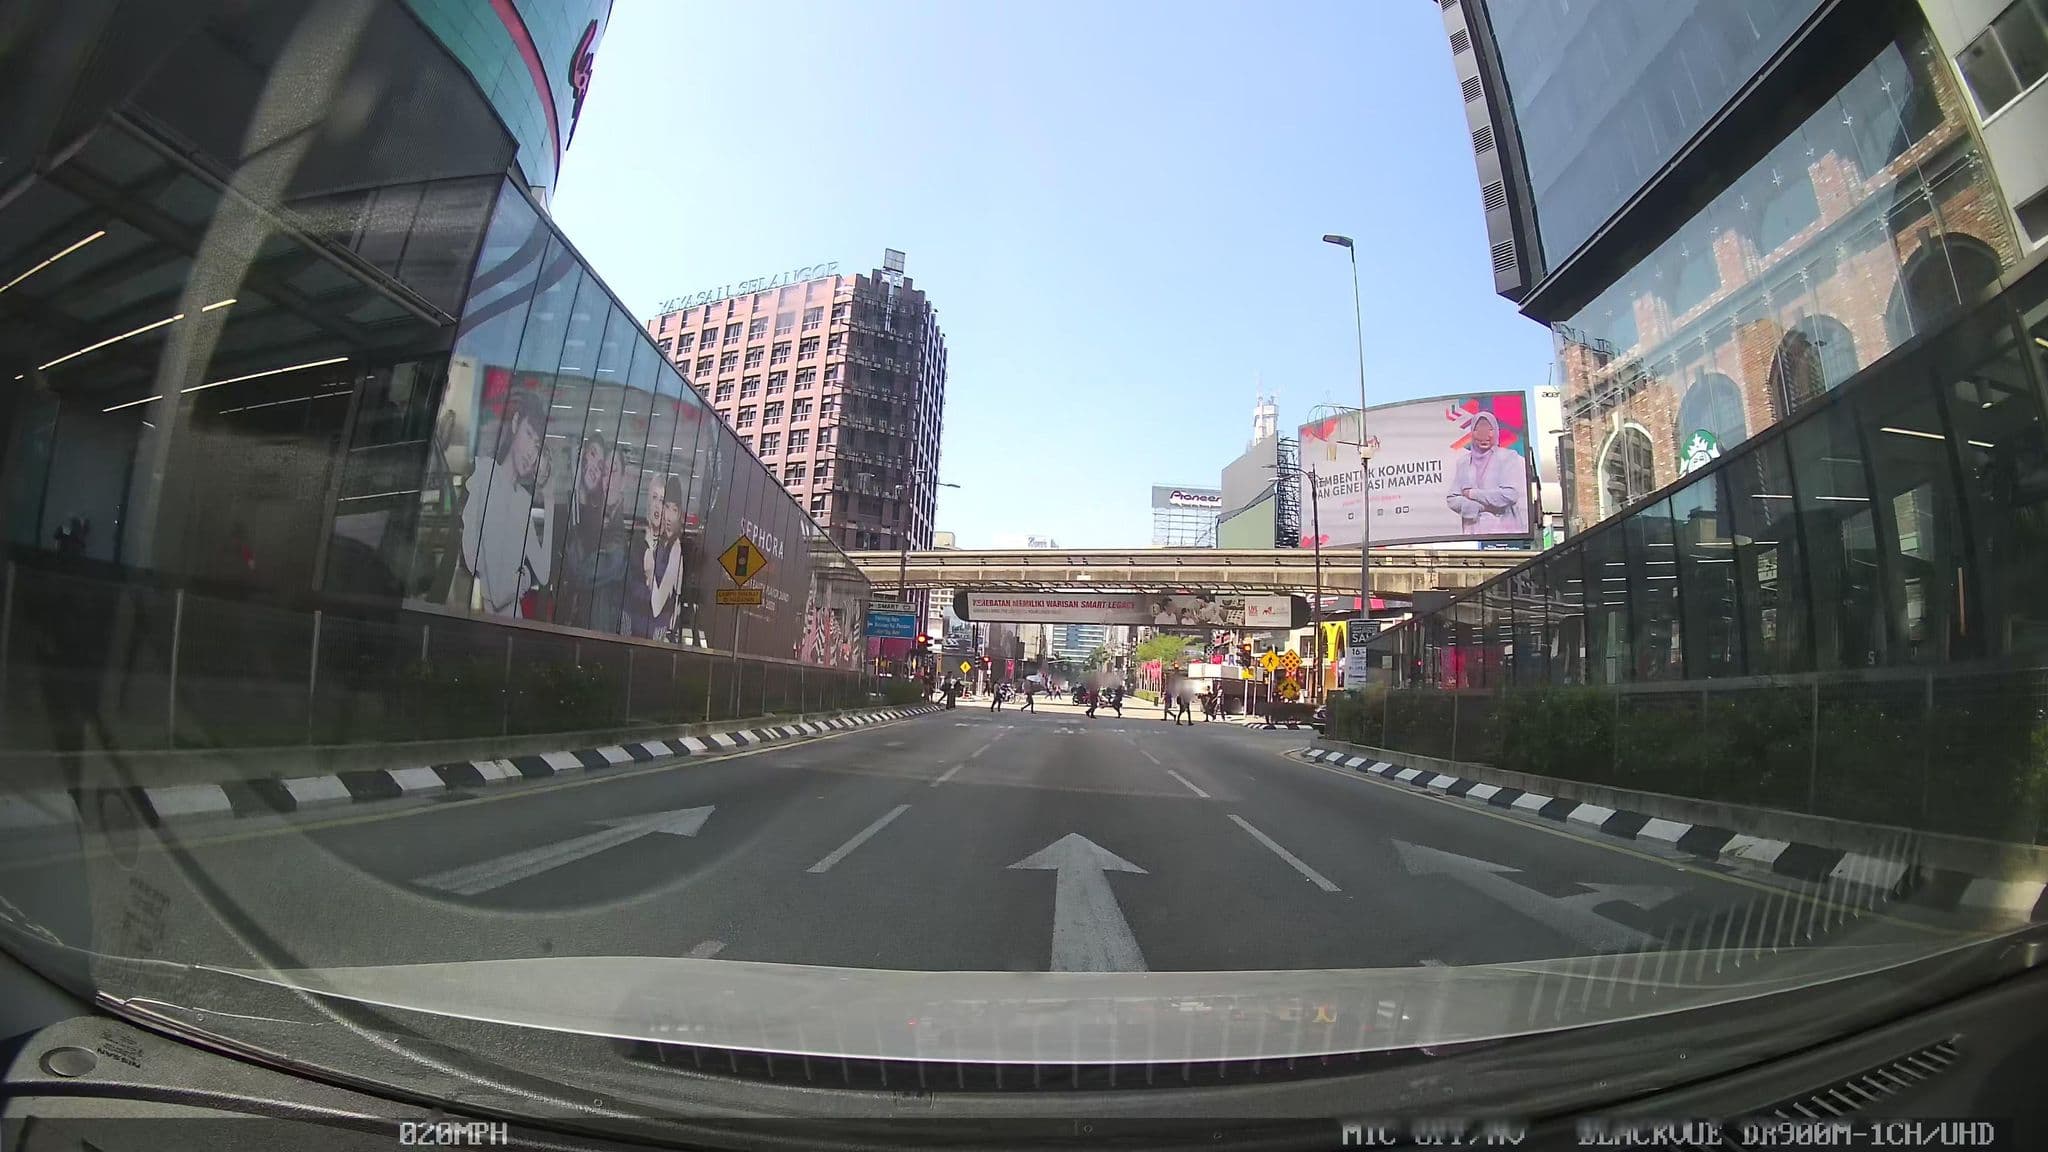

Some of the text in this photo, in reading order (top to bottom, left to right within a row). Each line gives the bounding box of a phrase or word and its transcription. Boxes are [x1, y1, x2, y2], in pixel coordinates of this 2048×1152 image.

[1379, 460, 1442, 478] KOMUNITI
[1332, 480, 1384, 497] GENEASI
[1388, 472, 1442, 489] MAMPAN
[1170, 490, 1221, 501] Pioneer
[741, 518, 785, 560] SEPHORA
[877, 602, 898, 610] SMART
[1046, 599, 1079, 609] WARISAN
[1080, 600, 1107, 610] SMART
